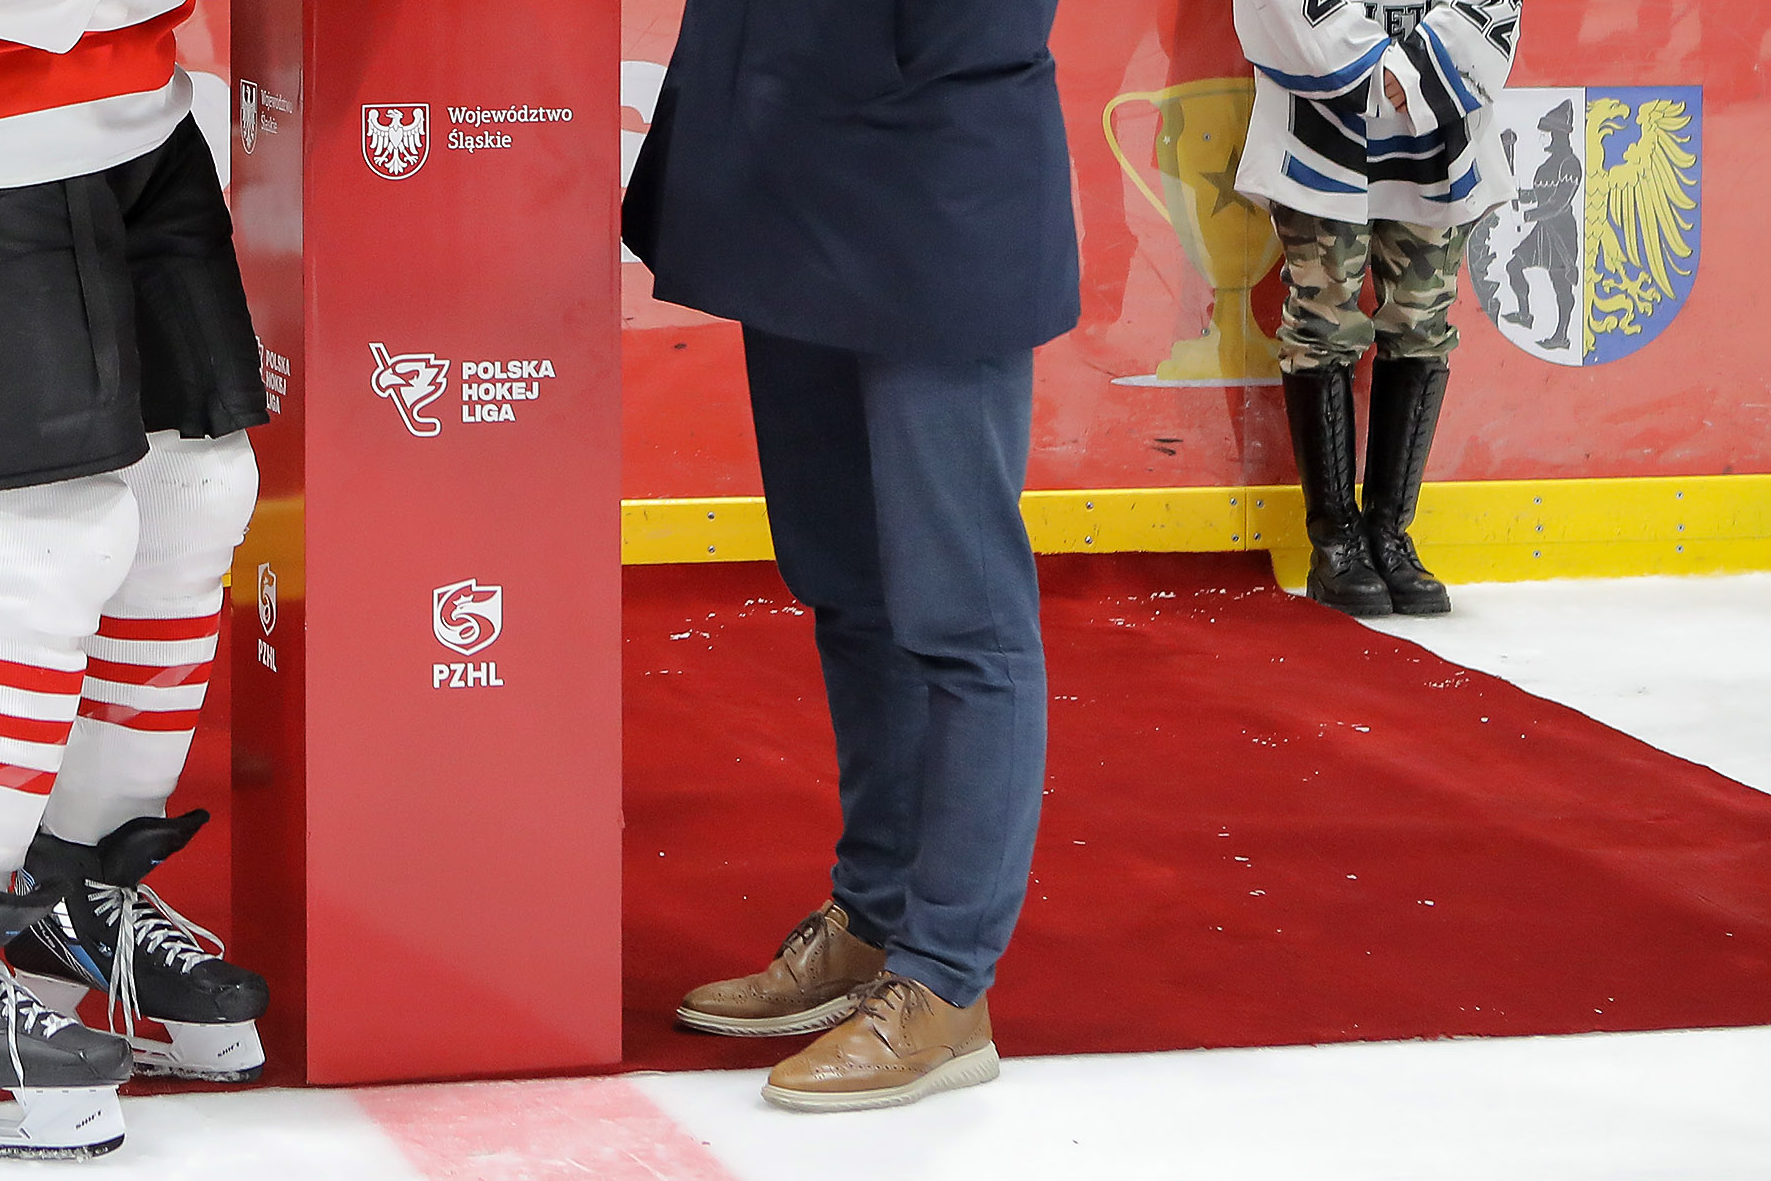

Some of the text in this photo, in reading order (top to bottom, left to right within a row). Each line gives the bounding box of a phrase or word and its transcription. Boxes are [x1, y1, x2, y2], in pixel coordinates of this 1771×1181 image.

[446, 103, 574, 128] Województwo
[446, 128, 513, 154] Śląskie
[265, 349, 291, 377] POLSKA
[461, 359, 557, 381] POLSKA
[461, 381, 540, 402] HOKEJ
[461, 403, 517, 423] LIGA
[257, 638, 278, 673] PZHL
[431, 661, 505, 689] PZHL
